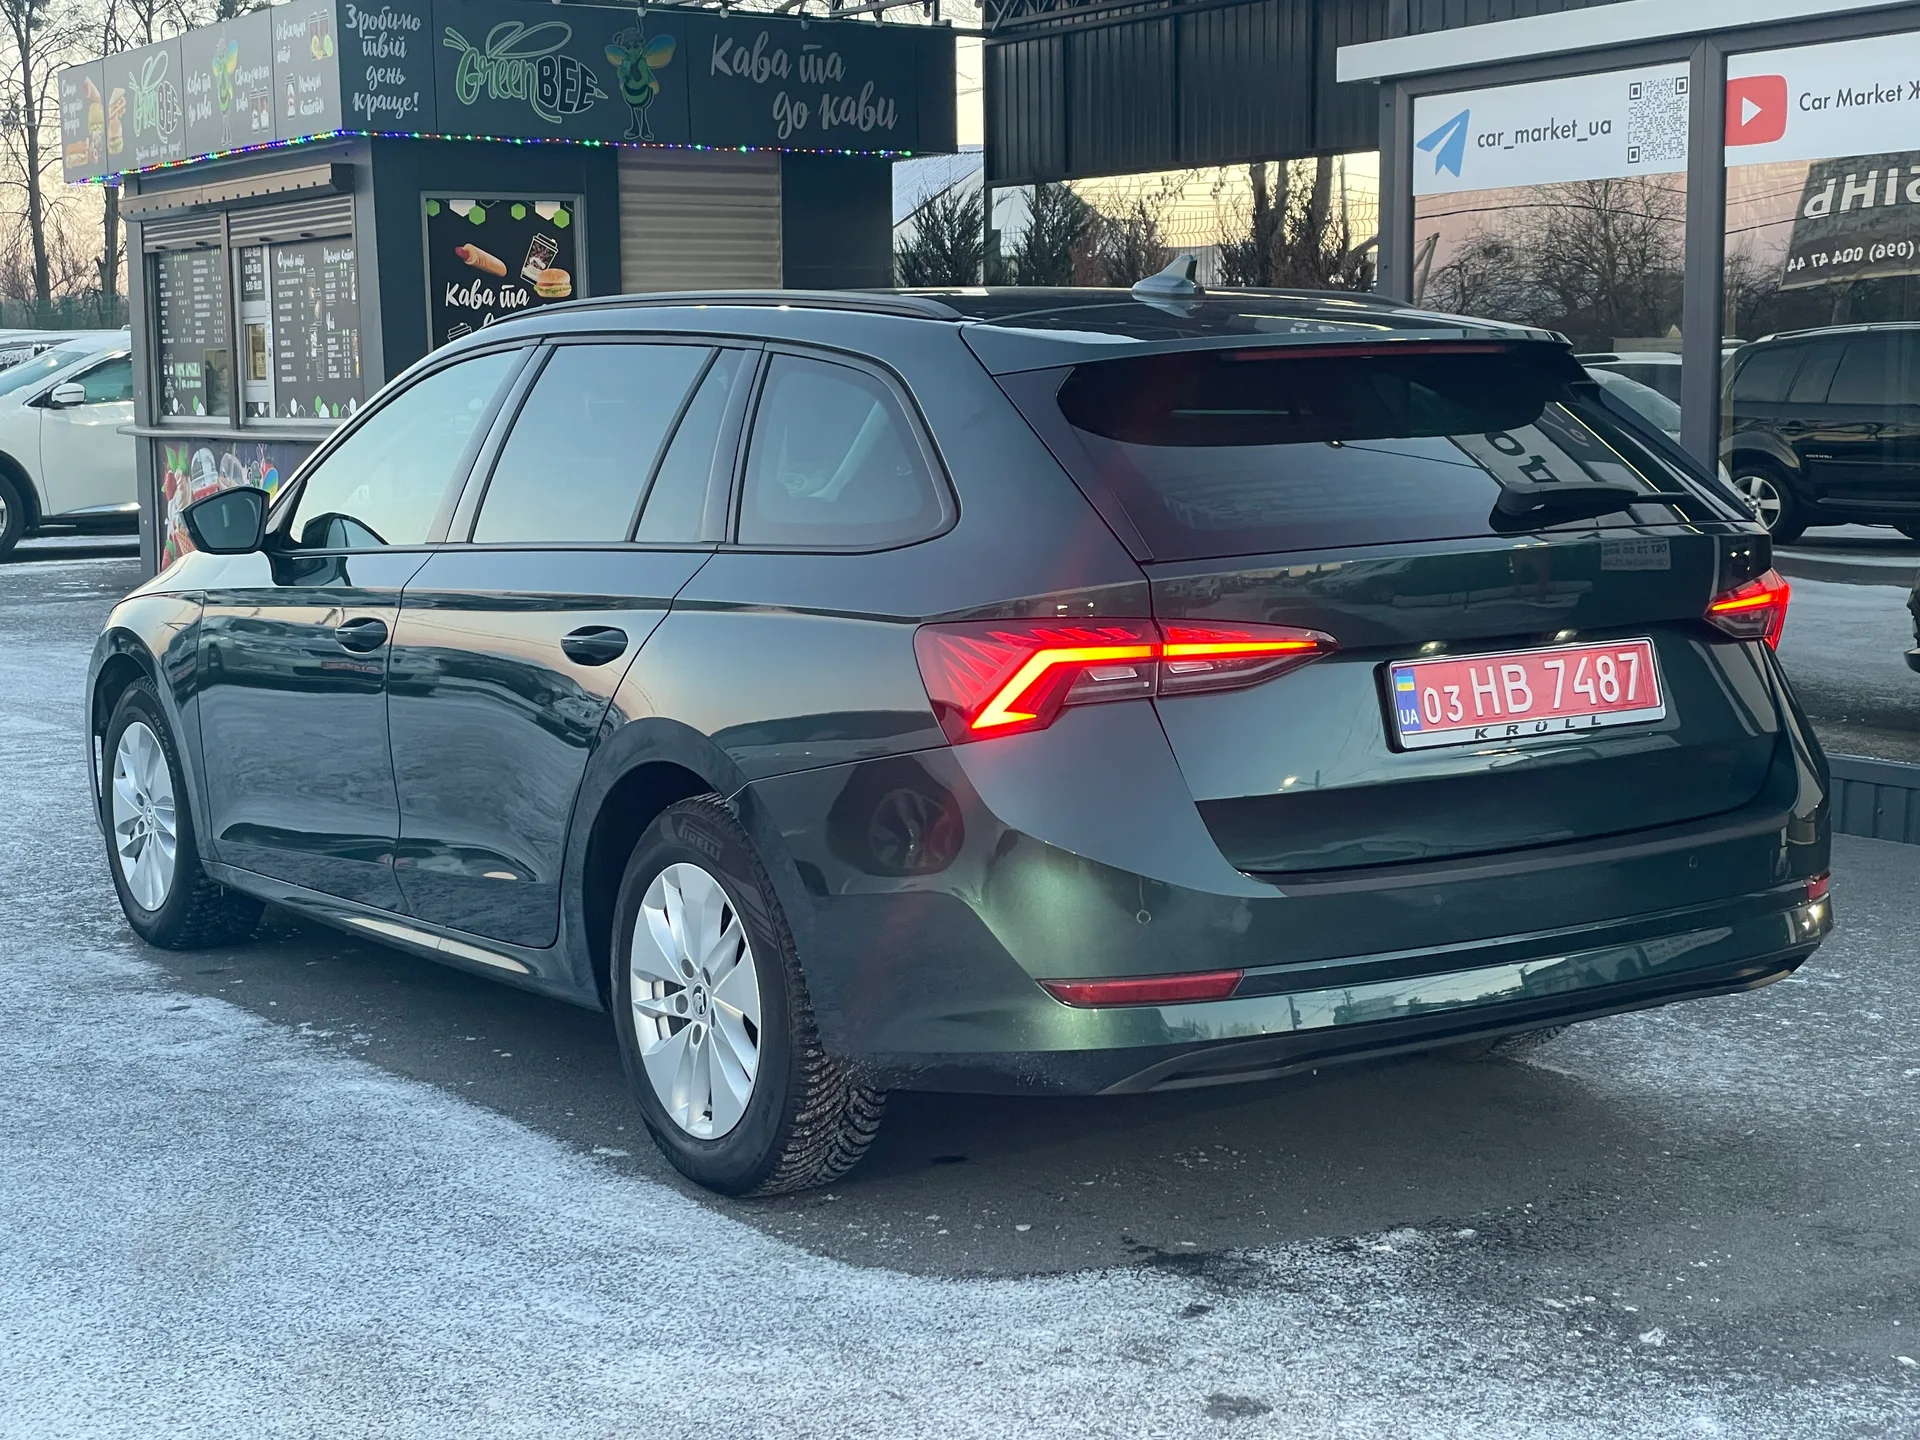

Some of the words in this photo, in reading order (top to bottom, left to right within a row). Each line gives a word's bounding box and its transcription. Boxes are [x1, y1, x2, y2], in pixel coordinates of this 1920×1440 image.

[345, 3, 422, 38] Зробимо
[362, 31, 408, 59] твій
[711, 30, 793, 84] Кава
[799, 44, 847, 85] та
[366, 66, 406, 91] день
[455, 47, 602, 118] GreenBEE
[353, 92, 419, 121] краще!
[773, 91, 810, 140] до
[818, 80, 899, 132] кави
[1799, 92, 1830, 111] Car
[1836, 83, 1903, 108] Market
[1477, 117, 1612, 150] car_market_ua
[445, 278, 496, 310] Кава
[500, 284, 530, 309] та
[1422, 685, 1464, 724] 03
[1469, 664, 1533, 717] HB
[1544, 652, 1639, 710] 7487
[1401, 708, 1420, 726] UA
[1474, 715, 1602, 740] KRÜLL
[677, 817, 724, 861] PIRELLI
